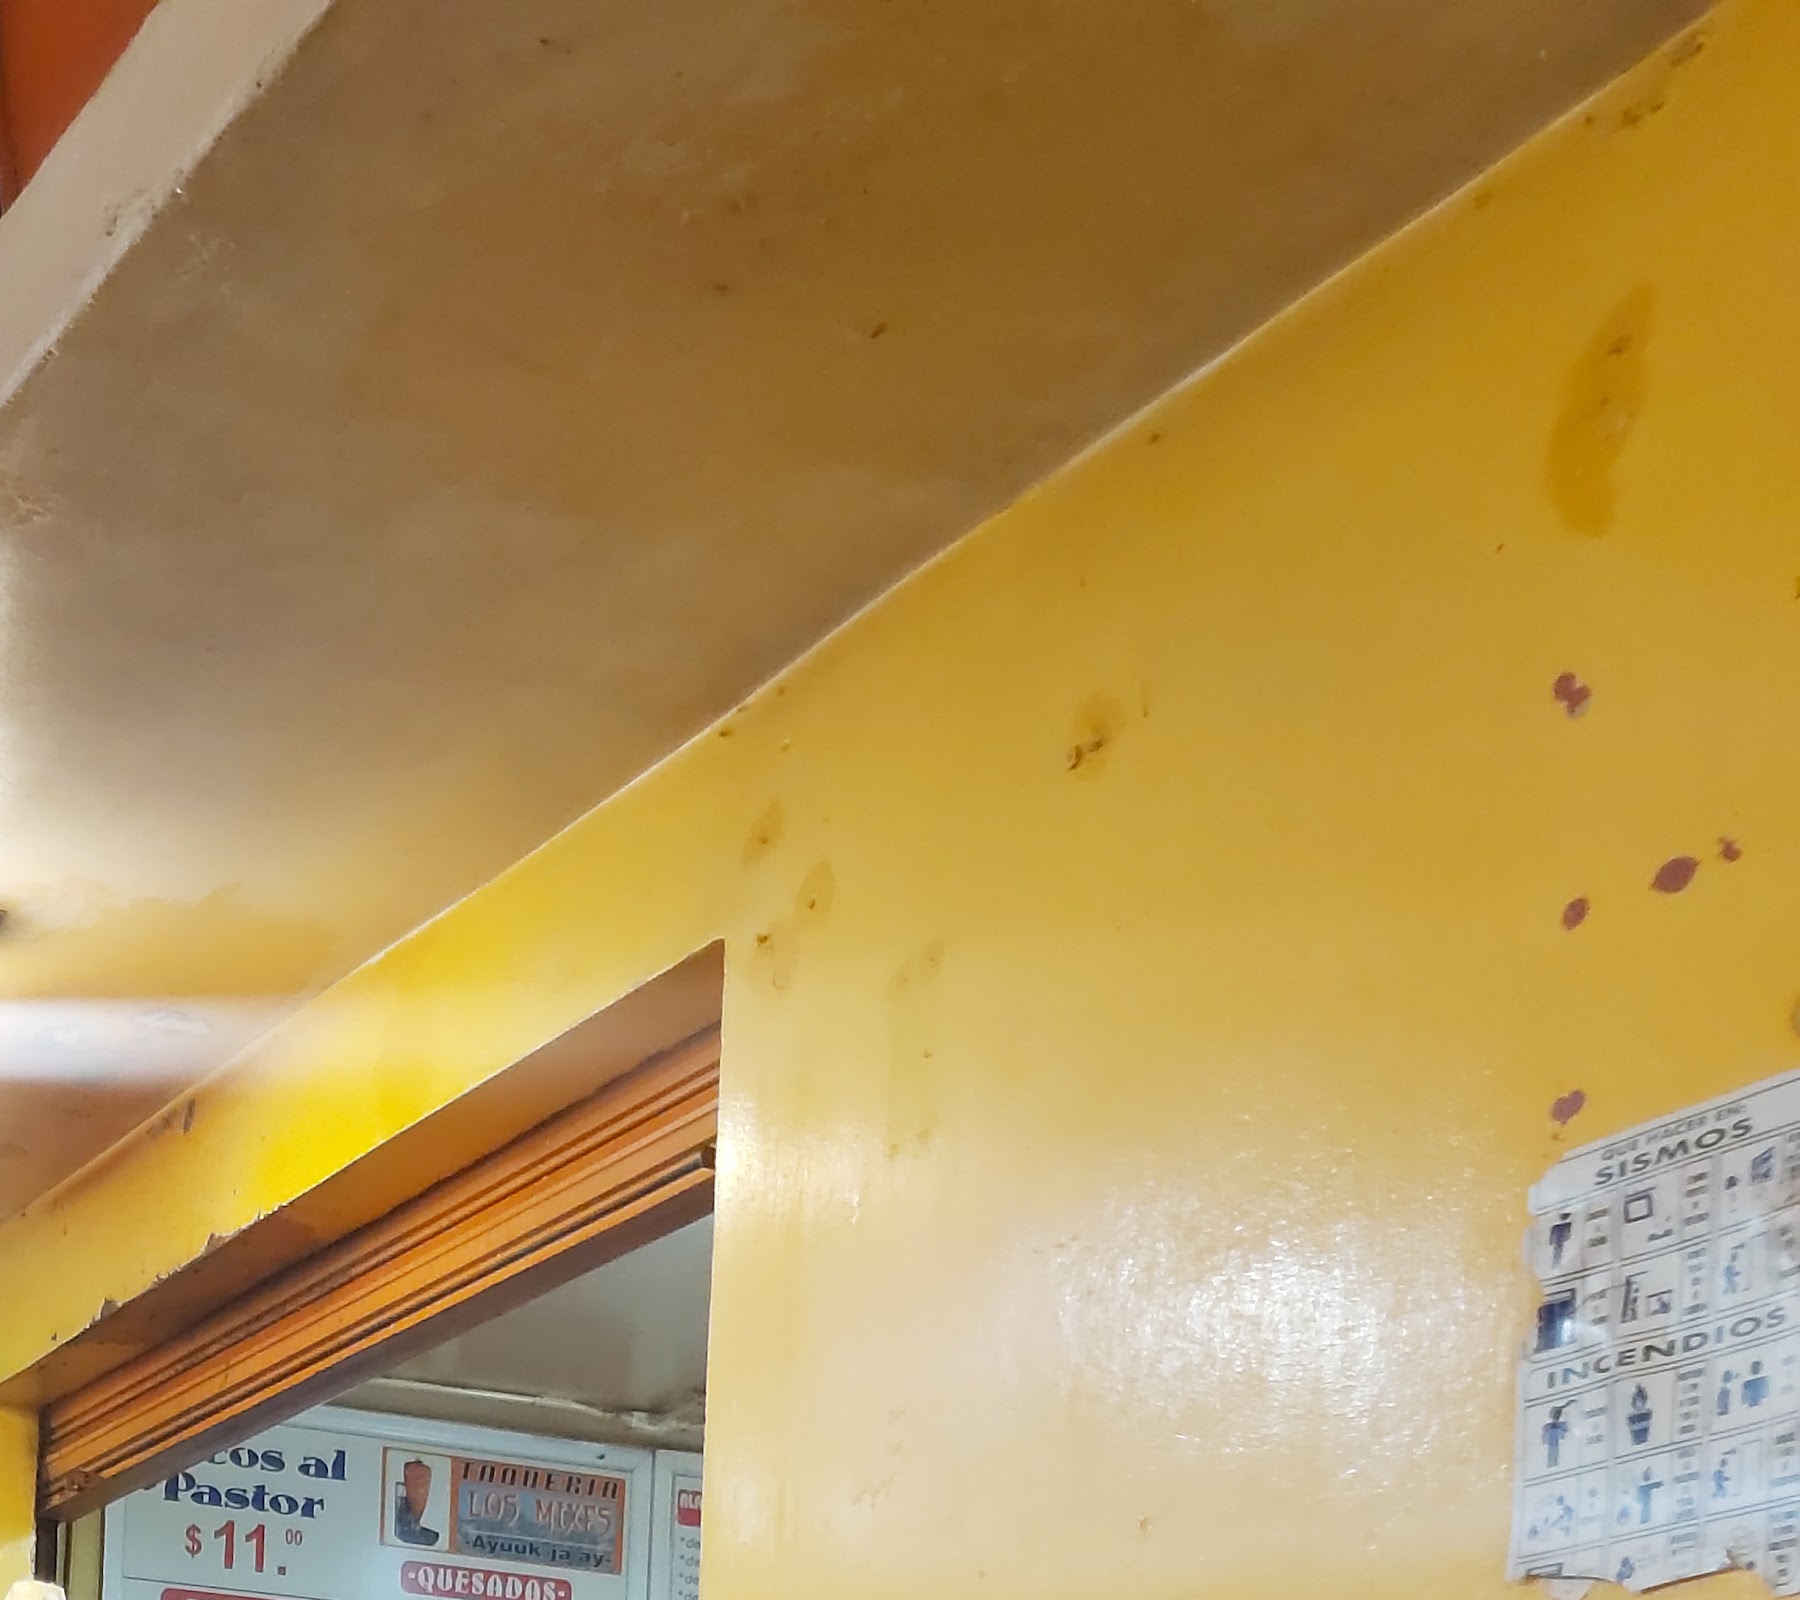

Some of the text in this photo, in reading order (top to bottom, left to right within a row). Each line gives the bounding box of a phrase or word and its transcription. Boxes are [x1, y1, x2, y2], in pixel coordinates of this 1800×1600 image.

[1594, 1118, 1753, 1186] SISMOS
[1547, 1306, 1787, 1389] INCENDIOS
[298, 1449, 347, 1481] al
[461, 1462, 618, 1500] TAQUERIA
[163, 1471, 324, 1519] Pastor
[468, 1491, 611, 1534] LOS MIXES
